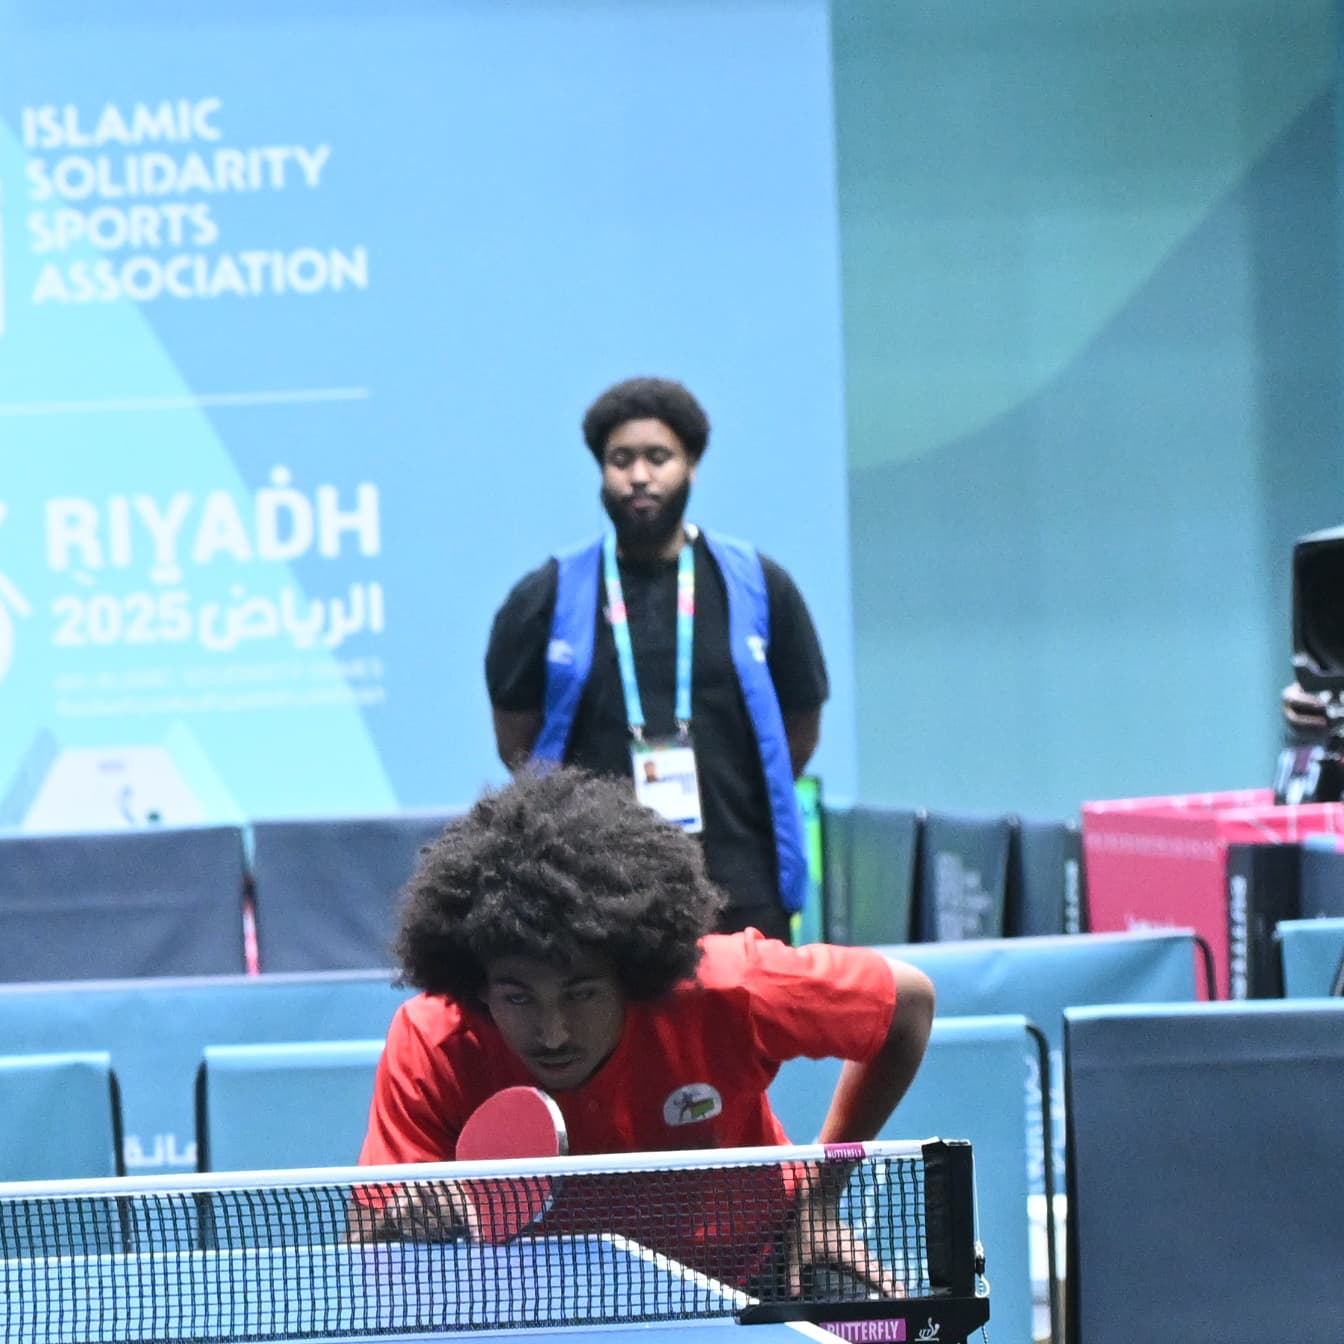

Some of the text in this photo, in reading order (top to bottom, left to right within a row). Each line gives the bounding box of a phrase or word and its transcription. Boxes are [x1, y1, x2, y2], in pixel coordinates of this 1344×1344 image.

[22, 98, 222, 149] ISLAMIC
[24, 144, 330, 202] SOLIDARITY
[27, 202, 218, 253] SPORTS
[31, 245, 369, 304] ASSOCIATION
[43, 472, 382, 582] RIYADH
[51, 583, 384, 652] 2025 الرياض
